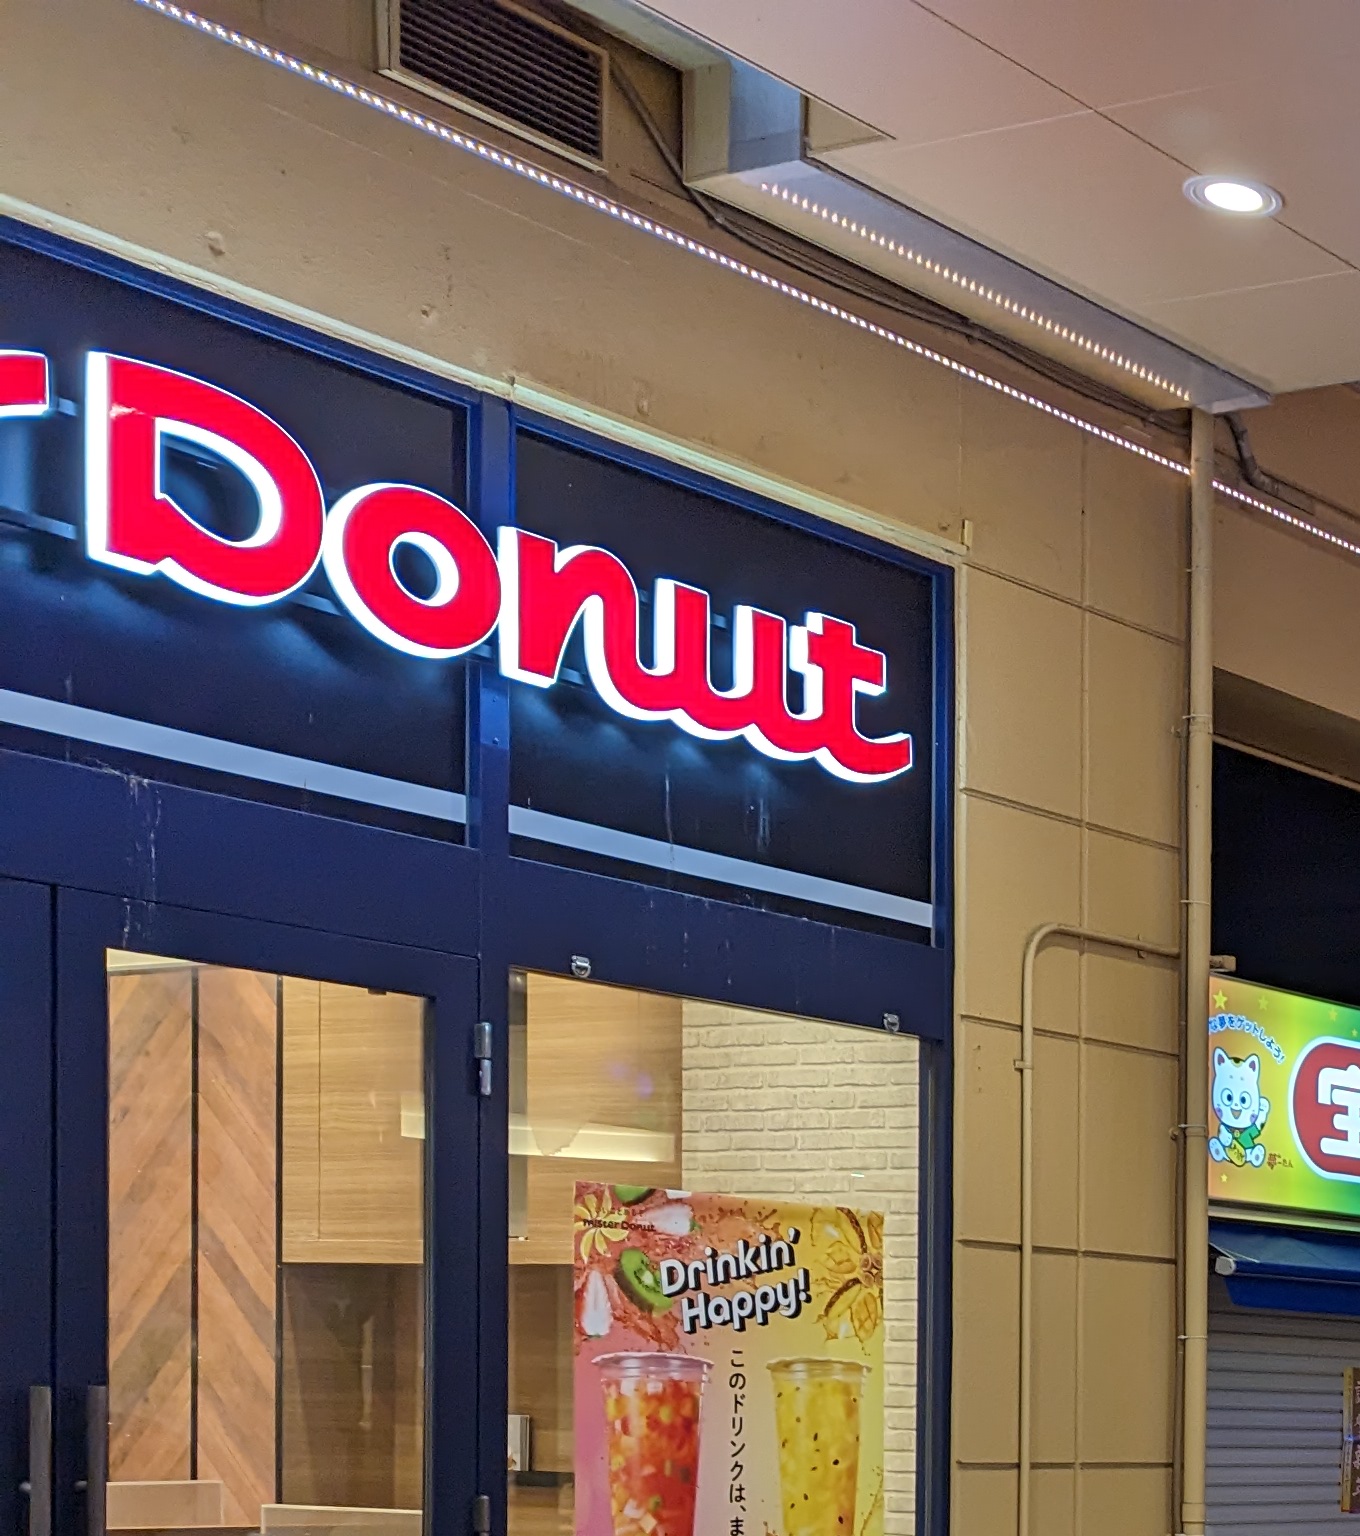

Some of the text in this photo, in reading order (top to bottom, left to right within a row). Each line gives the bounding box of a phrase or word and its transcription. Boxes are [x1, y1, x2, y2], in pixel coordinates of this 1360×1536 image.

[86, 351, 912, 783] Donut
[659, 1227, 800, 1298] Drinkin'
[681, 1267, 812, 1334] Happy!
